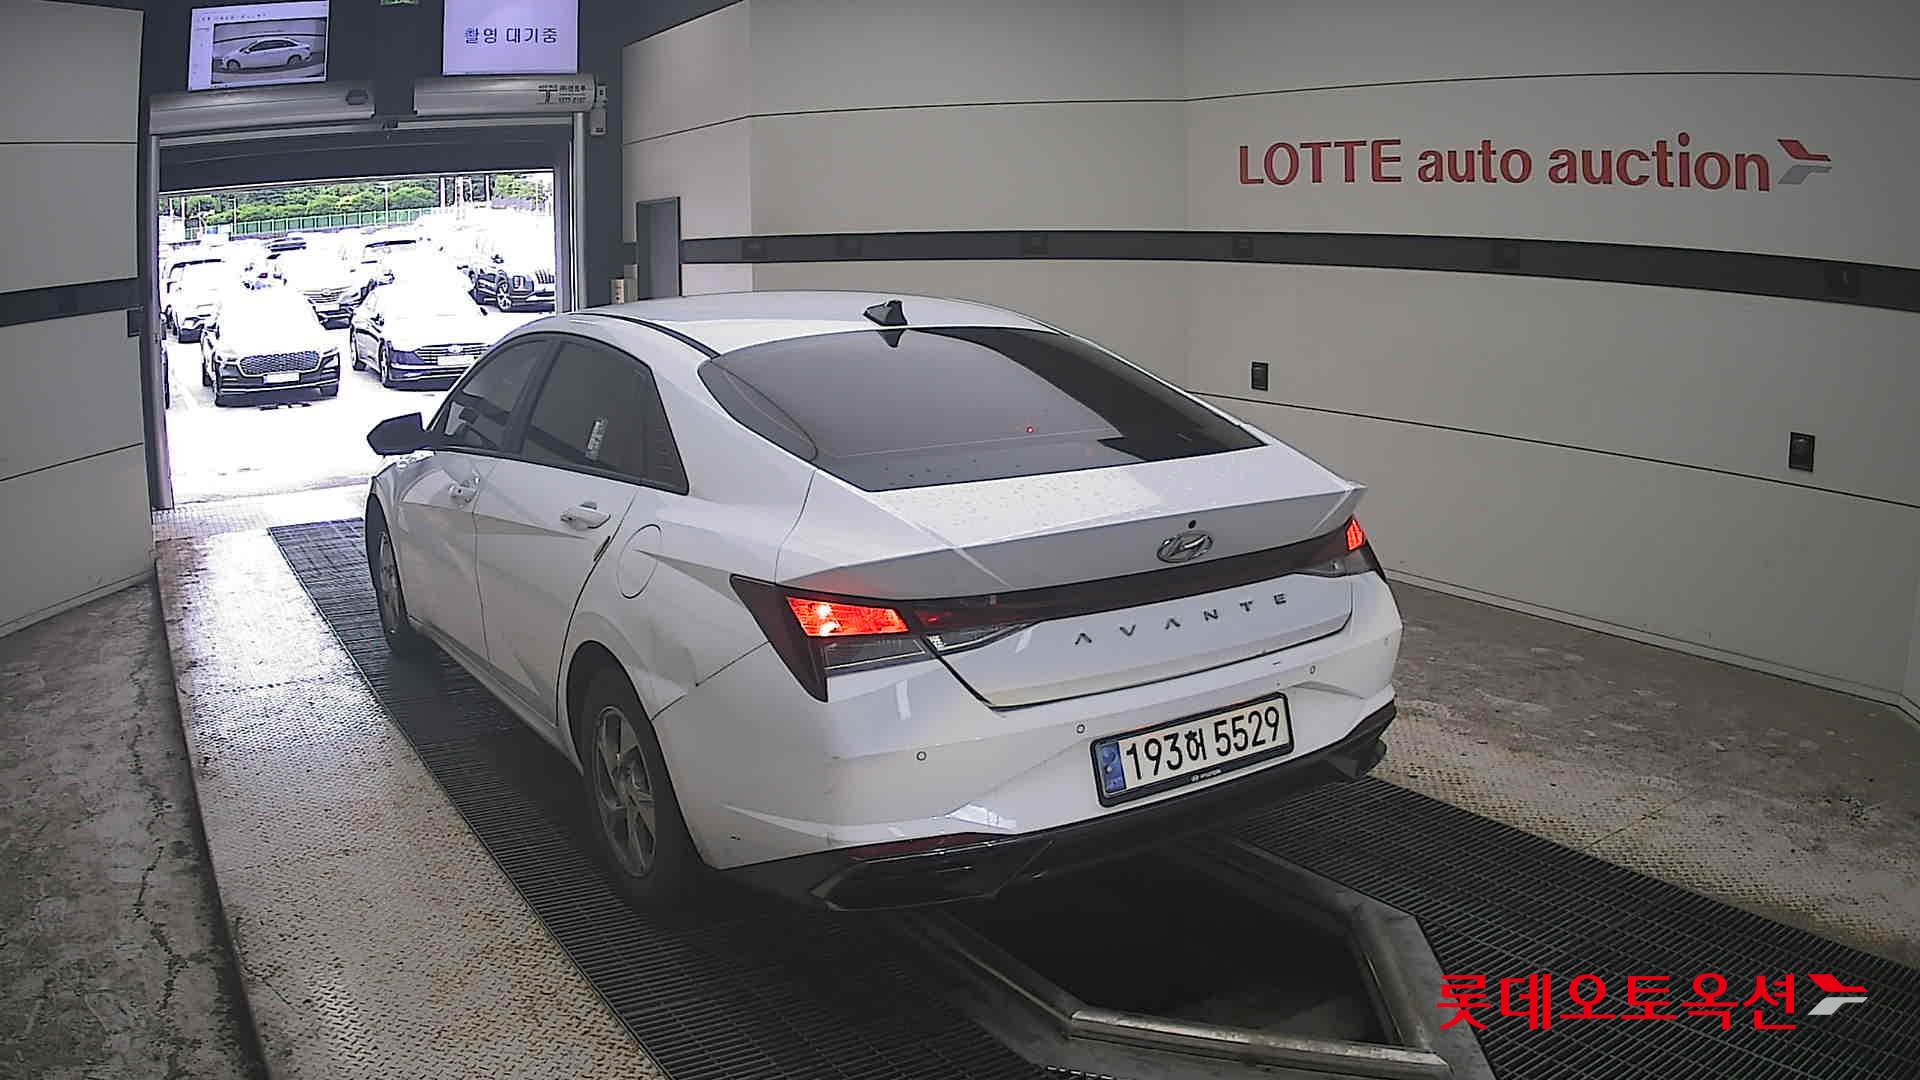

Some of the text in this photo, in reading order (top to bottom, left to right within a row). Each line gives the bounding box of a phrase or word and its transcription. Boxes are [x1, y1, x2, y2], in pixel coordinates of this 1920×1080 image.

[465, 27, 557, 44] 촬영 대기중
[1238, 132, 1771, 191] LOTTE auto auction
[1074, 593, 1287, 645] AVANTE
[1125, 706, 1280, 781] 193허 5529
